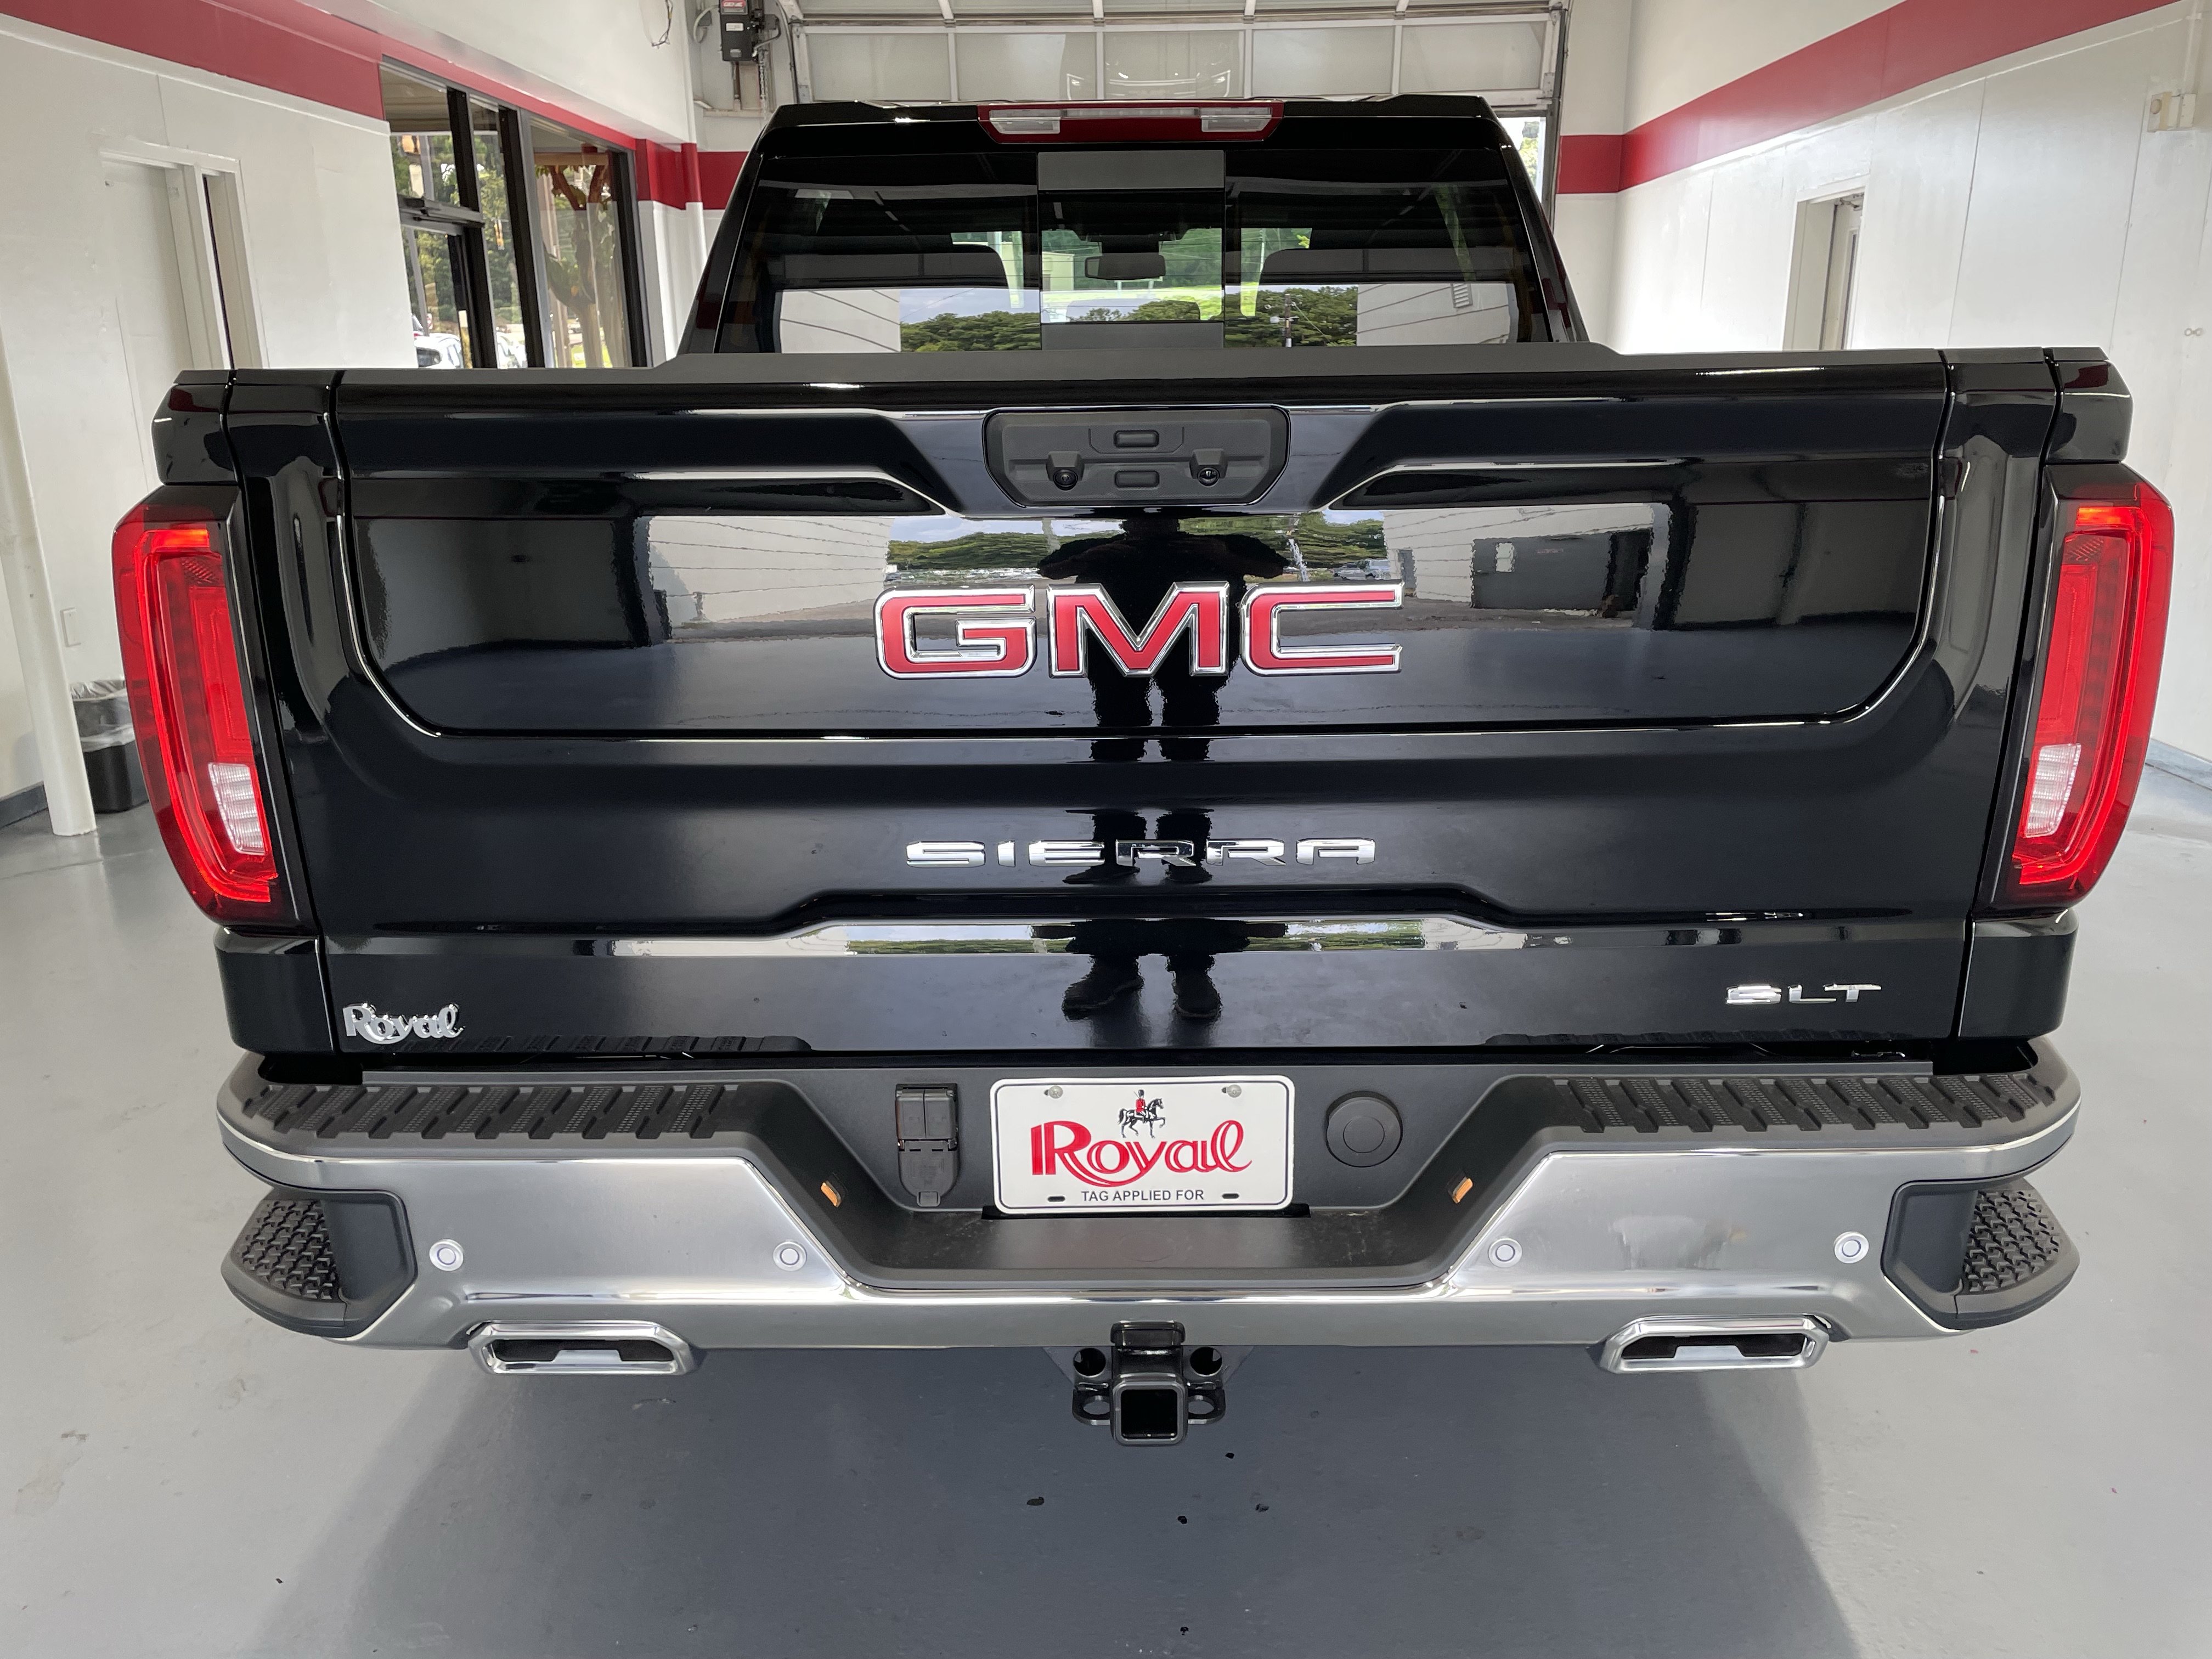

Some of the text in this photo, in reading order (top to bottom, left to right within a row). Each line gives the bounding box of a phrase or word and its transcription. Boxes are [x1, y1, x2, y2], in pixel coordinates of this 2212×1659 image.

[873, 582, 1404, 679] GMC
[906, 838, 1375, 868] SIERRA
[1726, 984, 1882, 1005] SLT
[342, 1003, 465, 1045] Royal
[1030, 1120, 1252, 1187] Royal
[1081, 1189, 1204, 1201] TAG APPLIED FOR
